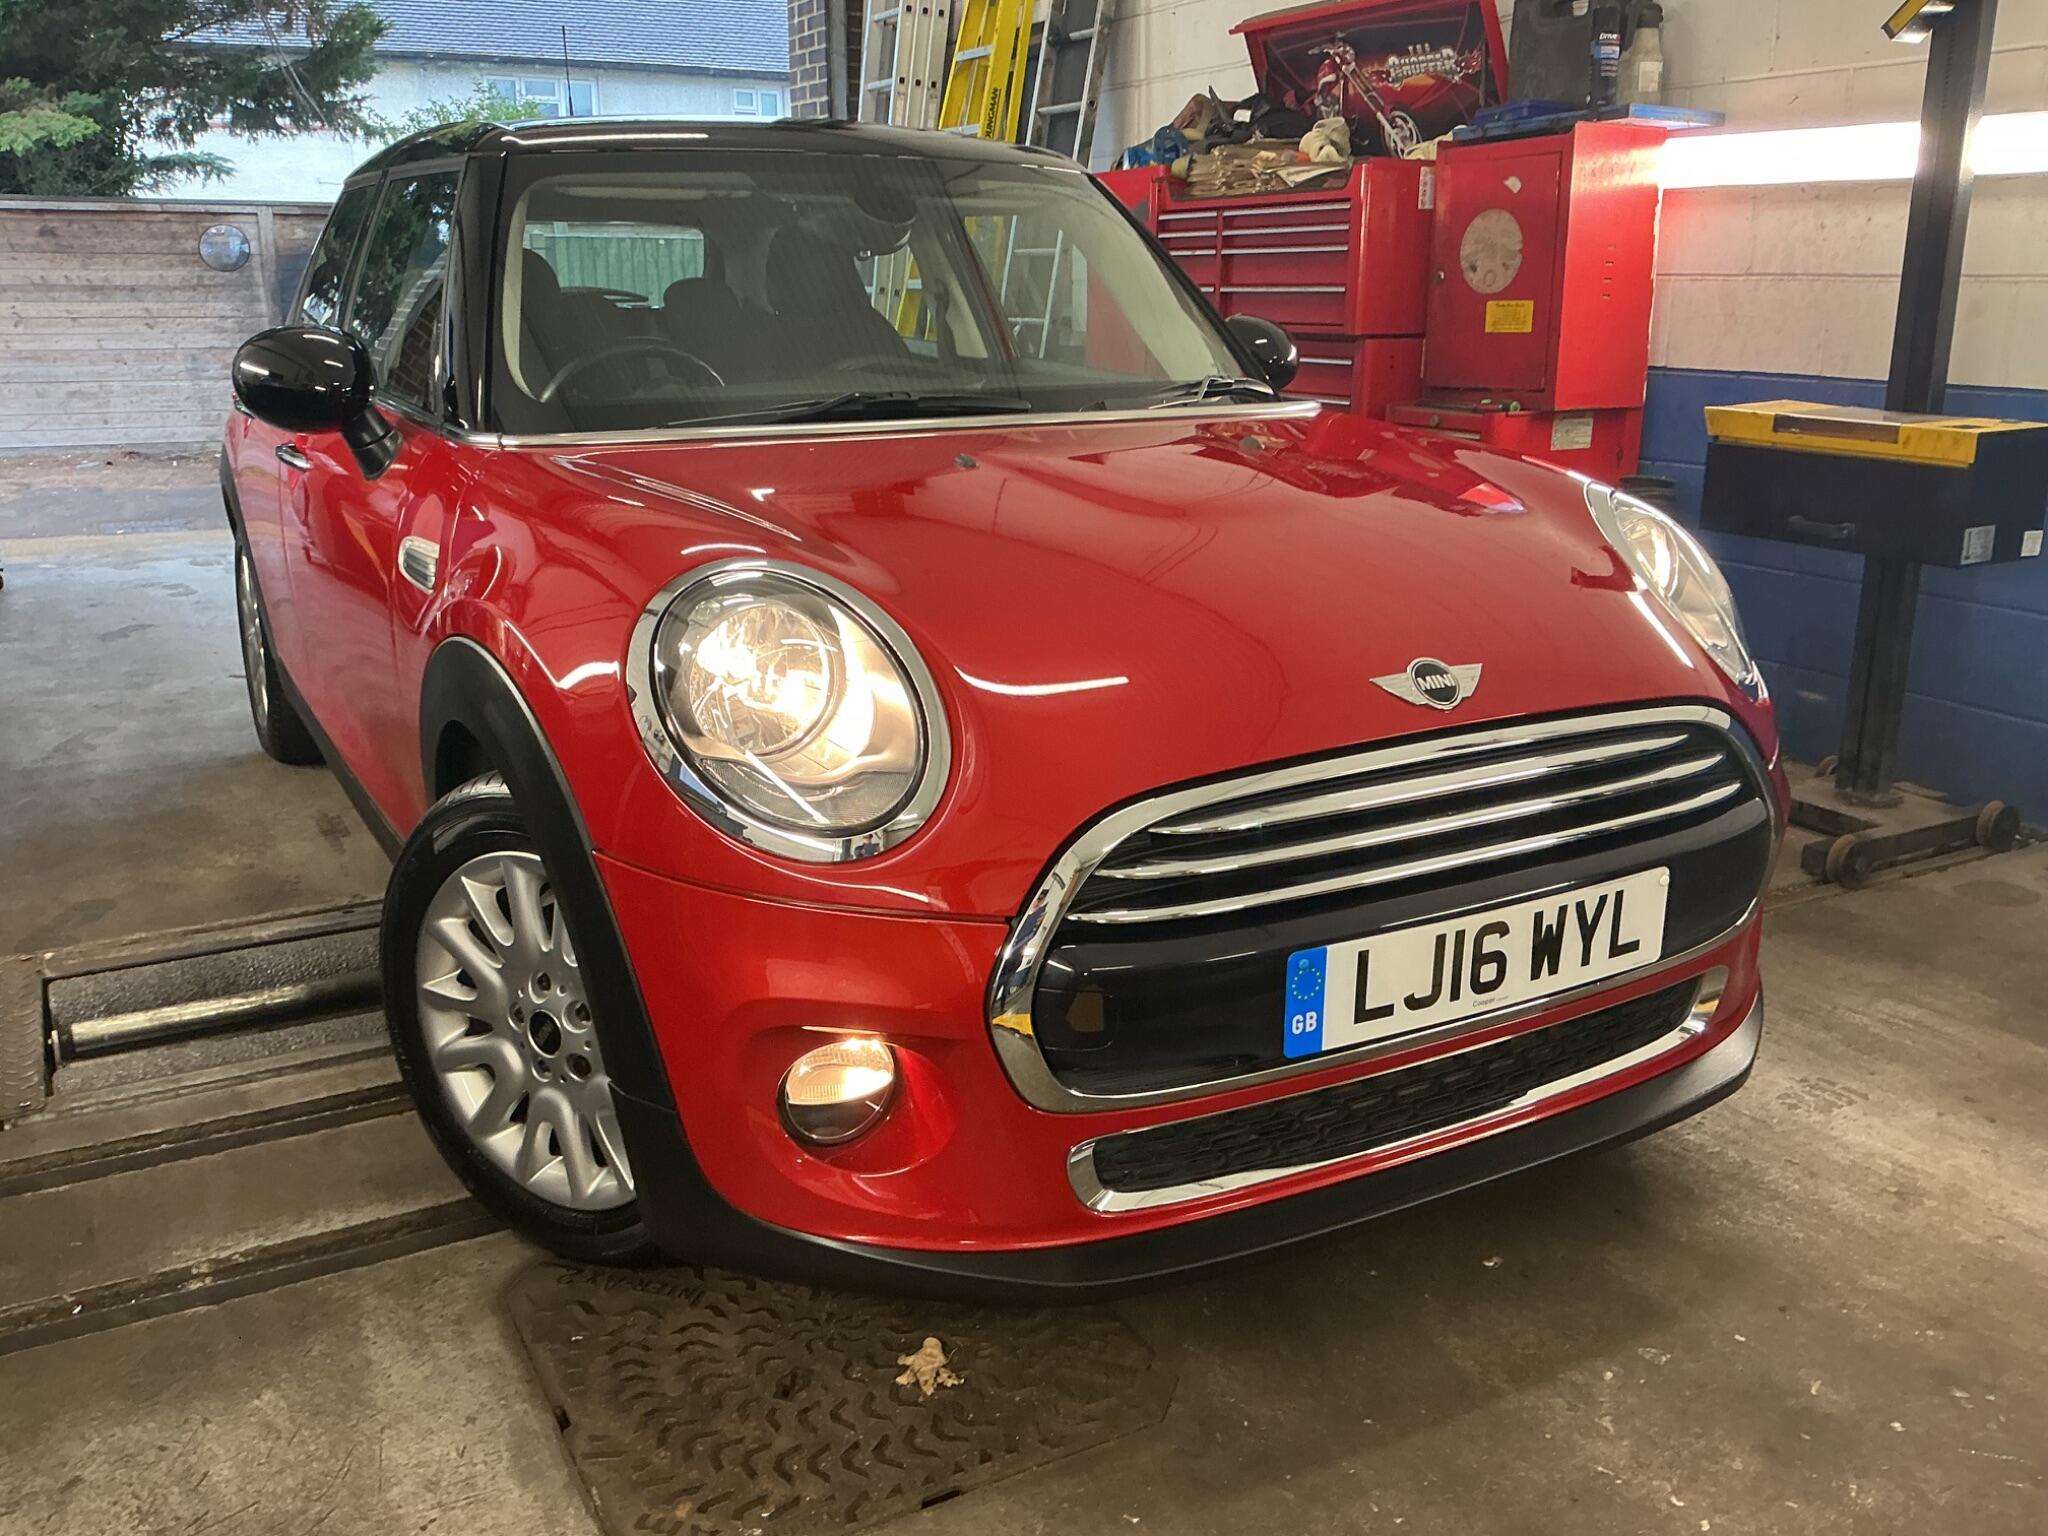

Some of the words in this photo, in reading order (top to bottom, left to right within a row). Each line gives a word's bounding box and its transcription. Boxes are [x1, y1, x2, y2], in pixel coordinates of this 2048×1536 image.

[1416, 673, 1456, 691] MINI
[1353, 920, 1511, 1025] LJ16
[1530, 889, 1640, 981] WYL
[1292, 1011, 1318, 1035] GB
